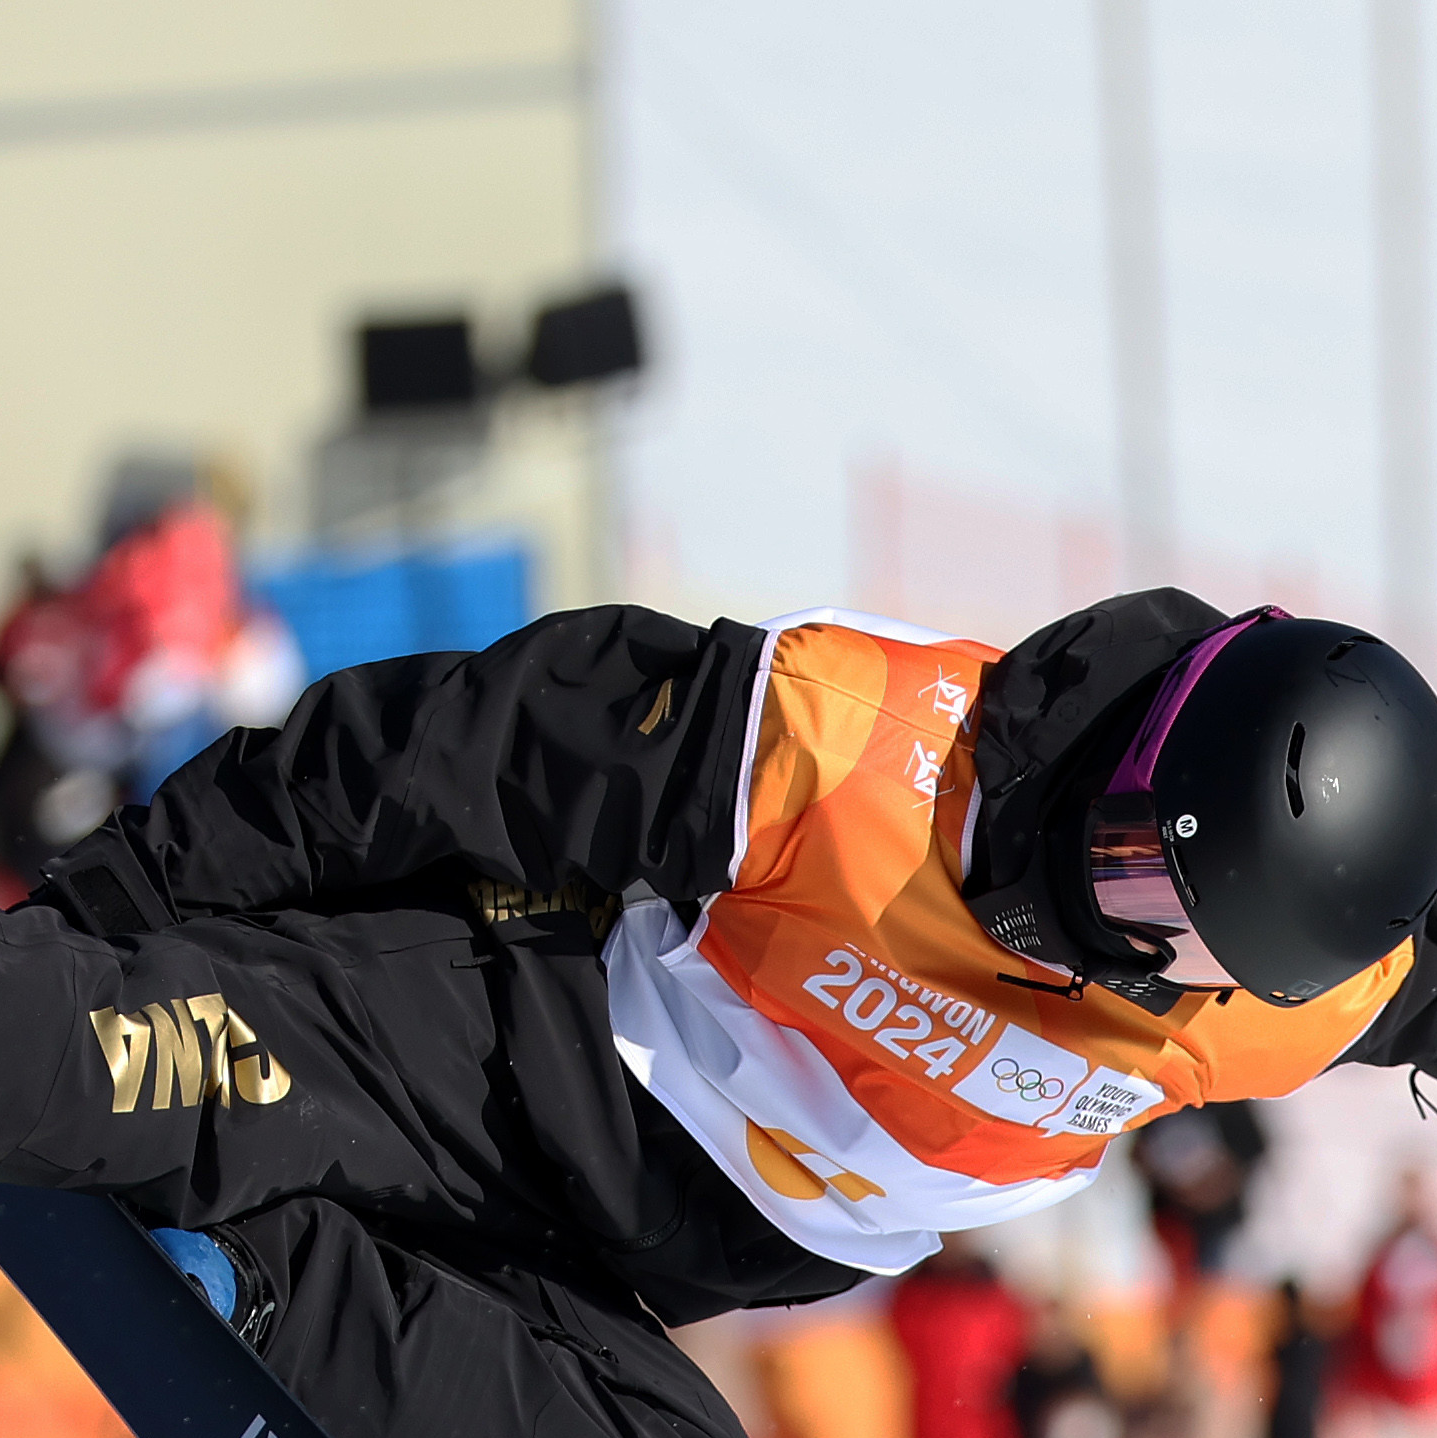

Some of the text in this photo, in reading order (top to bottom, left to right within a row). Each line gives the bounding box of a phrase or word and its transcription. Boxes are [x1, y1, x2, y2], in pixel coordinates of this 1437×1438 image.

[802, 948, 969, 1080] 2024
[1096, 1083, 1142, 1105] YOUTH
[1075, 1095, 1132, 1117] OLYMPIC
[1066, 1113, 1112, 1133] GAMES
